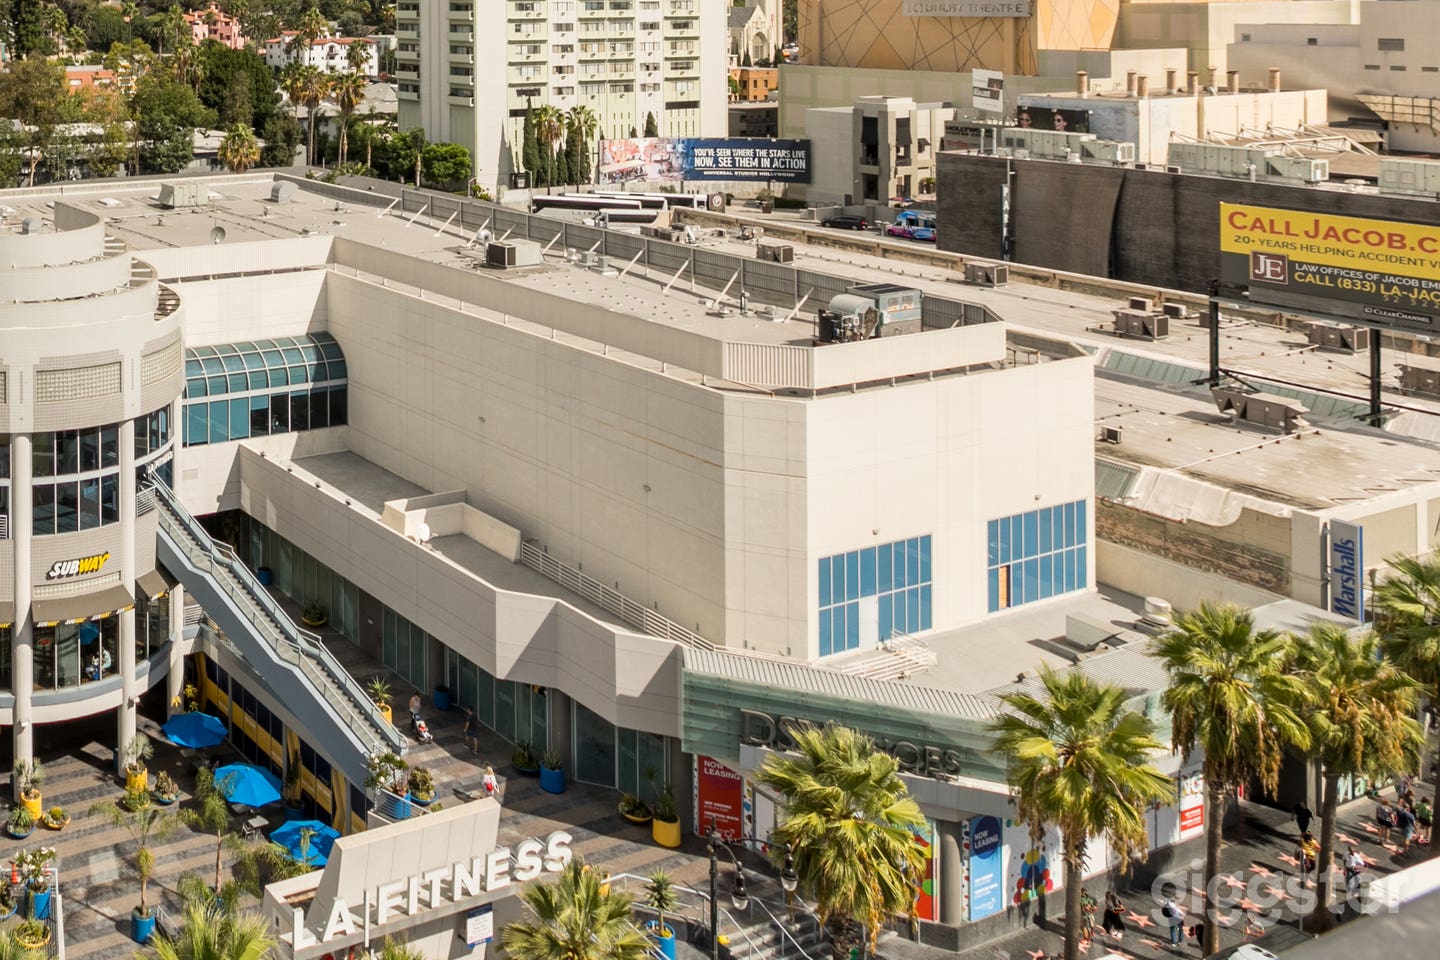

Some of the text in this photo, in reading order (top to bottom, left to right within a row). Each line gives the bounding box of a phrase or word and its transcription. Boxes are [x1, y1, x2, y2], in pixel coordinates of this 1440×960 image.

[716, 148, 732, 157] SEEN
[732, 148, 755, 157] WHERE
[755, 149, 768, 157] THE
[769, 149, 791, 158] STARS
[792, 150, 806, 158] LIVE
[718, 156, 733, 168] SEE
[734, 157, 759, 168] THEM
[761, 158, 771, 168] IN
[772, 158, 807, 170] ACTION
[1227, 211, 1300, 237] CALL
[1258, 238, 1297, 250] YEARS
[1300, 244, 1356, 258] HELPING
[1358, 250, 1426, 267] ACCIDENT
[1294, 272, 1335, 287] CALL
[1337, 279, 1377, 294] (833)
[1295, 263, 1319, 273] LAW
[1319, 266, 1363, 279] OFFICES
[1382, 275, 1420, 287] JACOB
[48, 552, 111, 578] SUBWAY
[1333, 538, 1356, 617] Marshalls
[974, 830, 988, 840] NOW
[974, 834, 999, 849] LEASING
[291, 830, 573, 951] LA FITNESS
